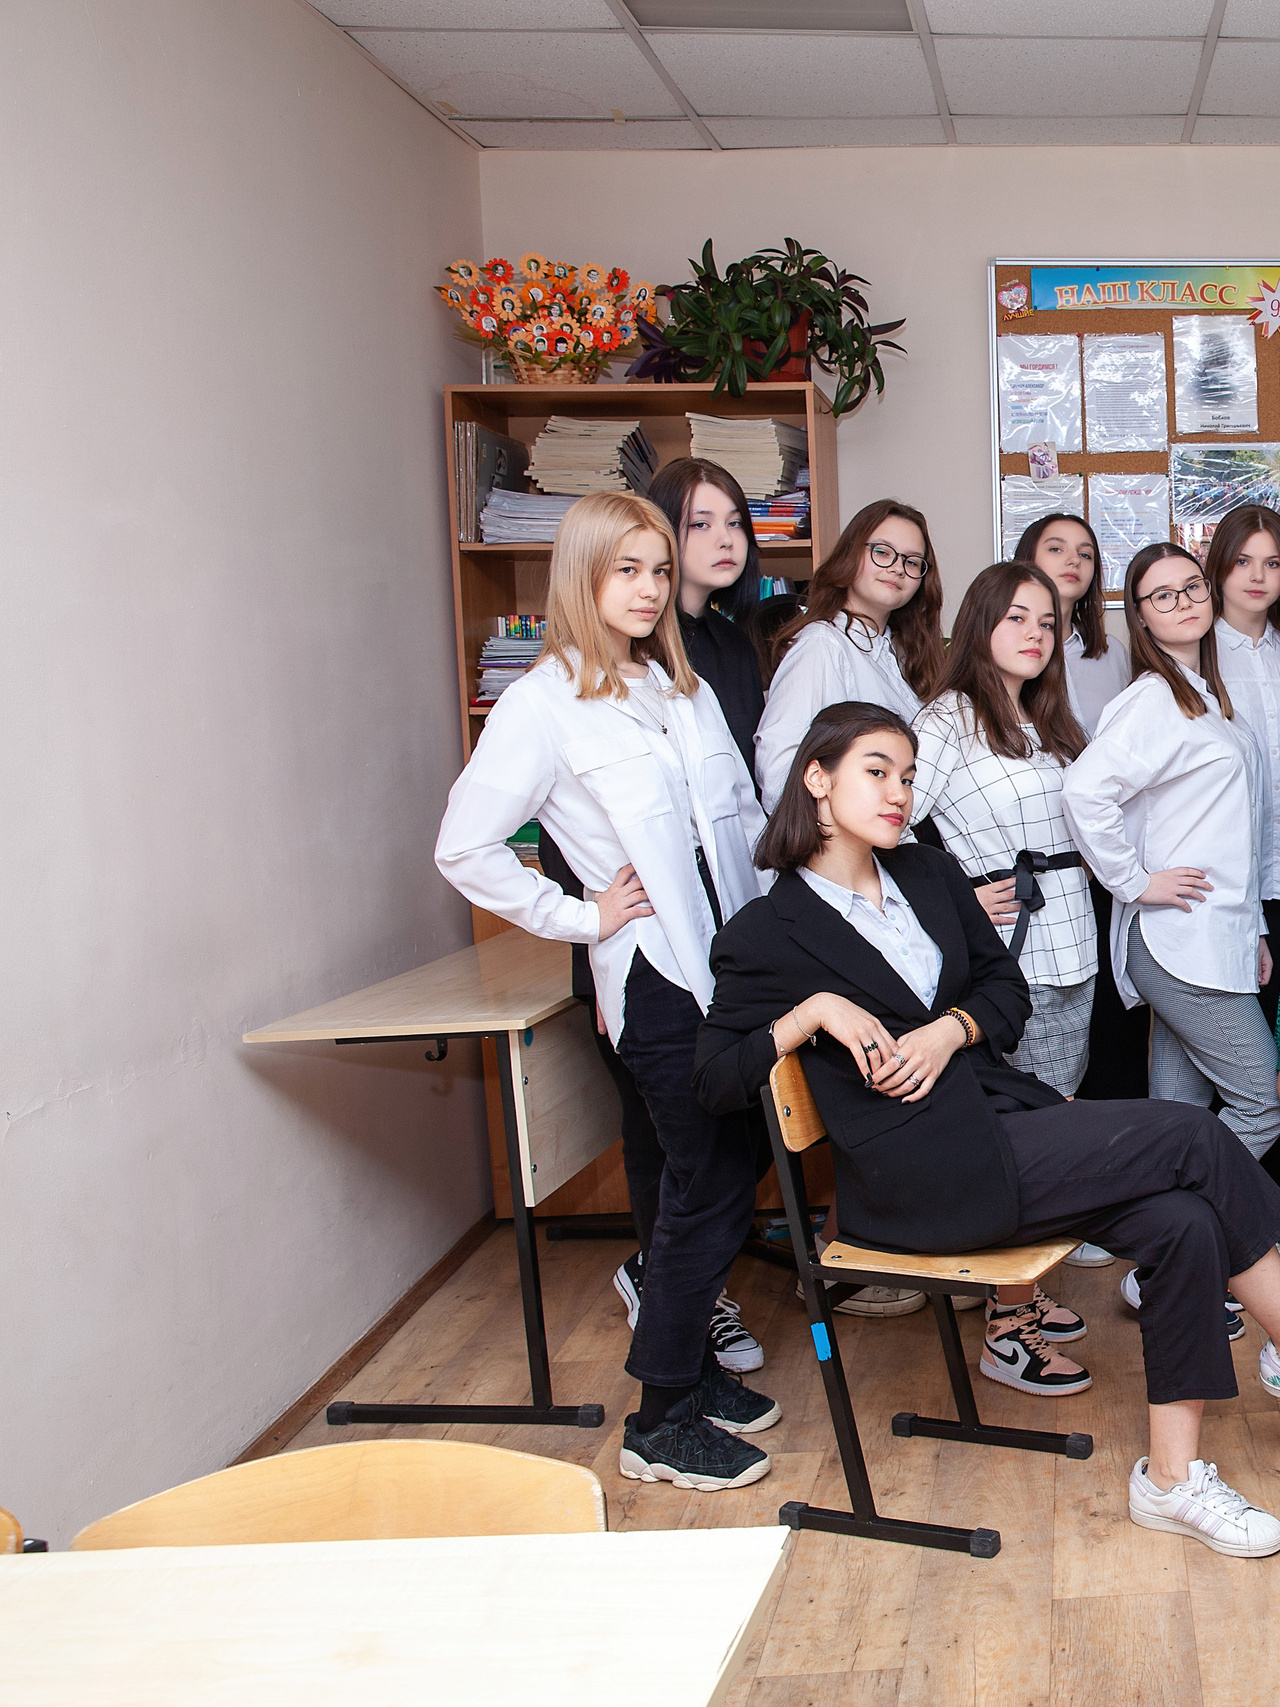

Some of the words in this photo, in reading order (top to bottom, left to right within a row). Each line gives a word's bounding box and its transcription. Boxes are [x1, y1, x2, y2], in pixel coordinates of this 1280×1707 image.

[1054, 281, 1131, 308] НАШ
[1136, 281, 1238, 305] КЛАСС
[1003, 308, 1035, 321] ЛУЧШИЕ
